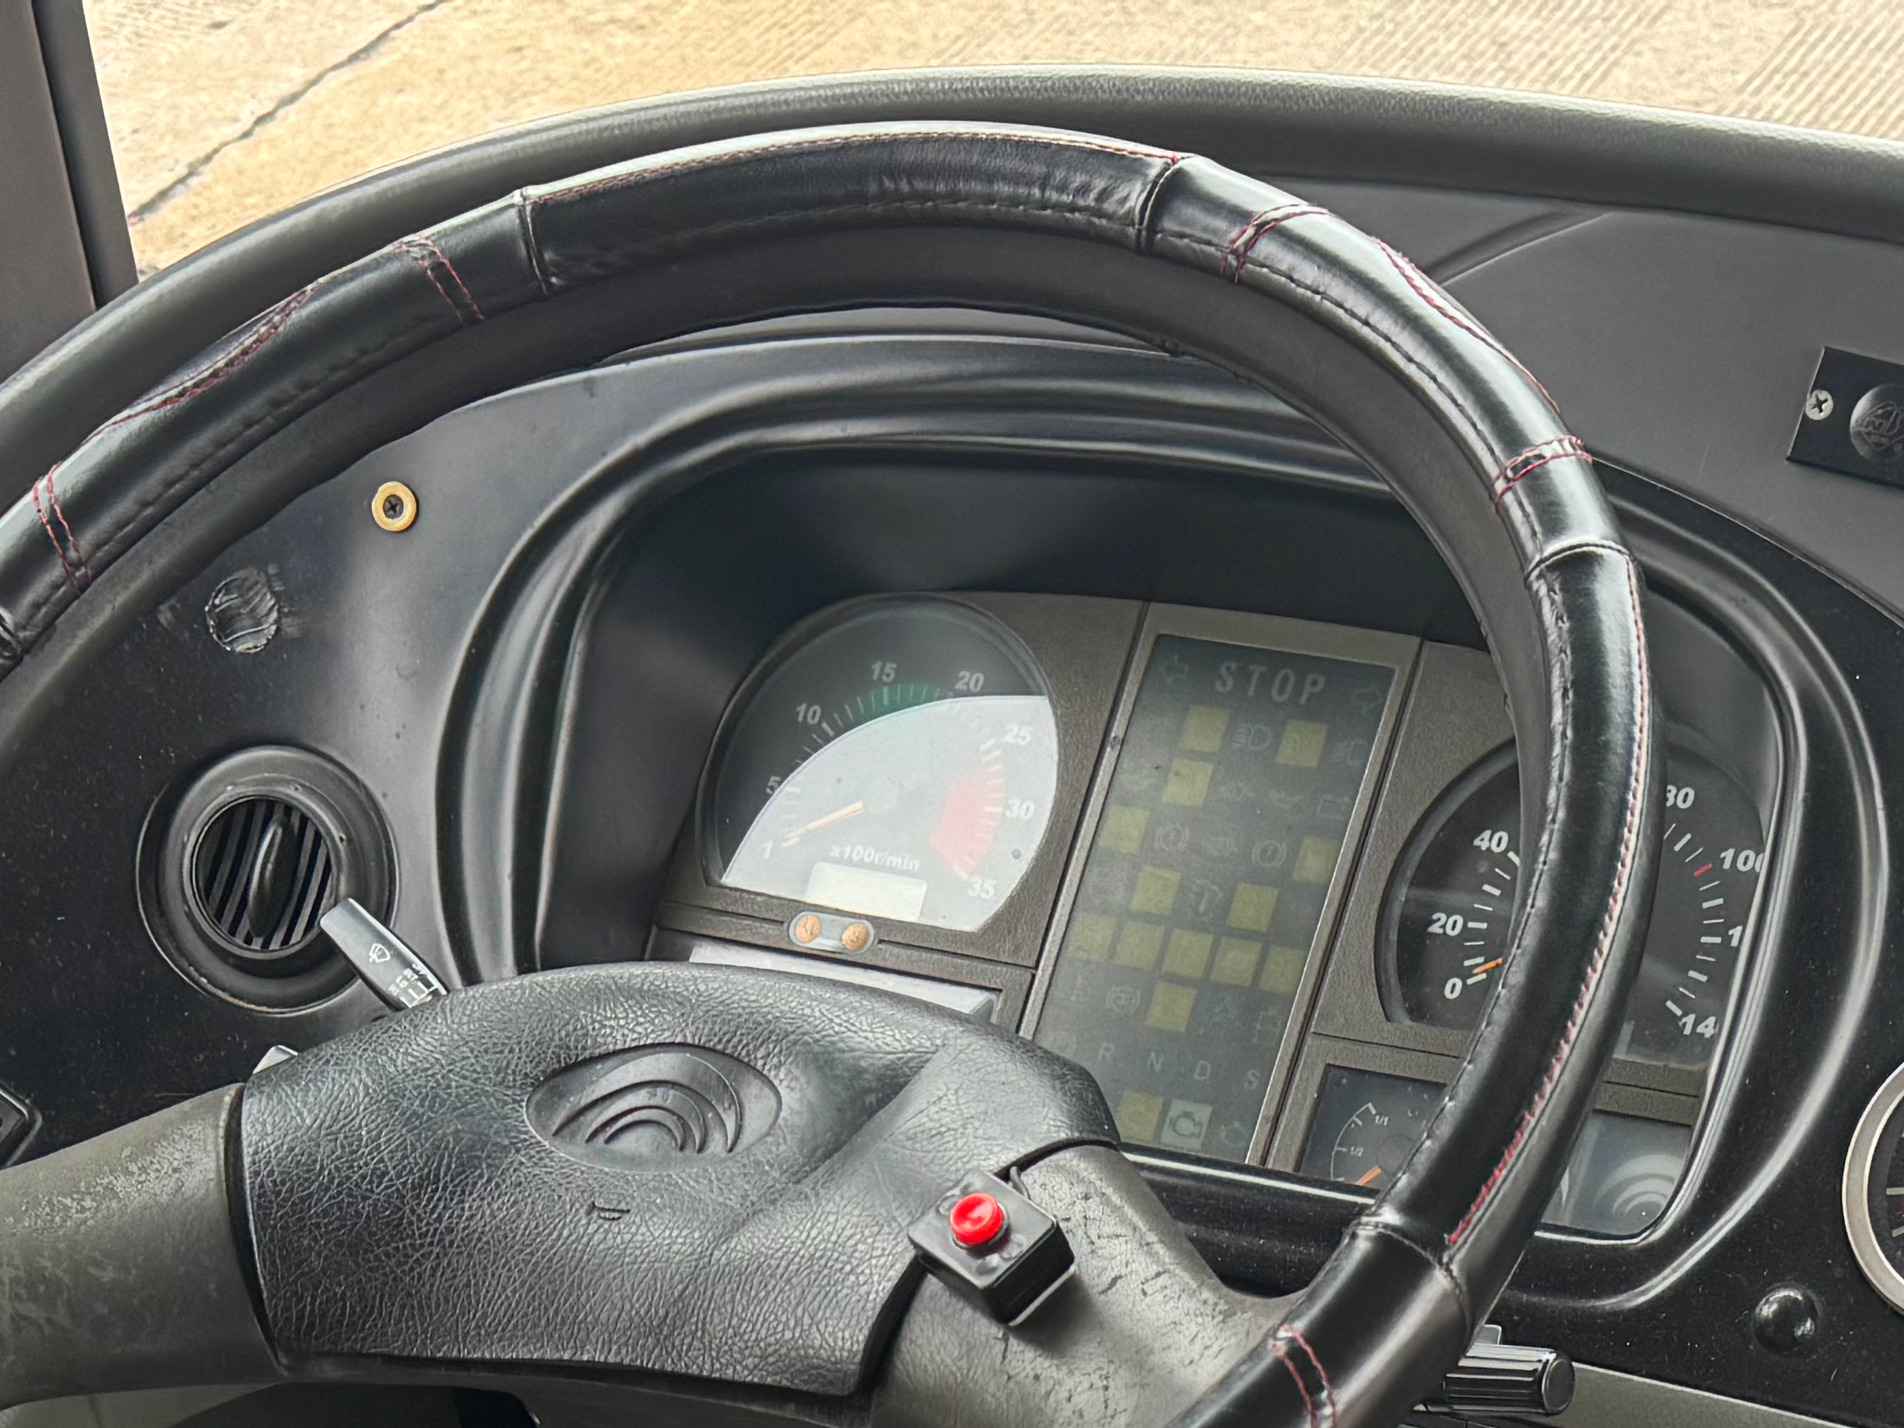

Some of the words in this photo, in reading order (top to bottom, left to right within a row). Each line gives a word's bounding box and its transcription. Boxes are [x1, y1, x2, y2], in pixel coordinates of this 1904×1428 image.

[870, 661, 897, 683] 15
[955, 671, 984, 692] 20
[1215, 661, 1327, 705] STOP
[796, 703, 822, 725] 10
[1002, 724, 1034, 746] 25
[765, 776, 781, 795] 5
[1006, 800, 1035, 821] 30
[1473, 830, 1509, 854] 40
[967, 877, 996, 899] 35
[1427, 913, 1464, 937] 20
[1443, 978, 1463, 1000] 0
[1098, 1043, 1115, 1063] R
[1147, 1051, 1164, 1073] N
[1193, 1060, 1212, 1080] D
[1243, 1069, 1261, 1090] S
